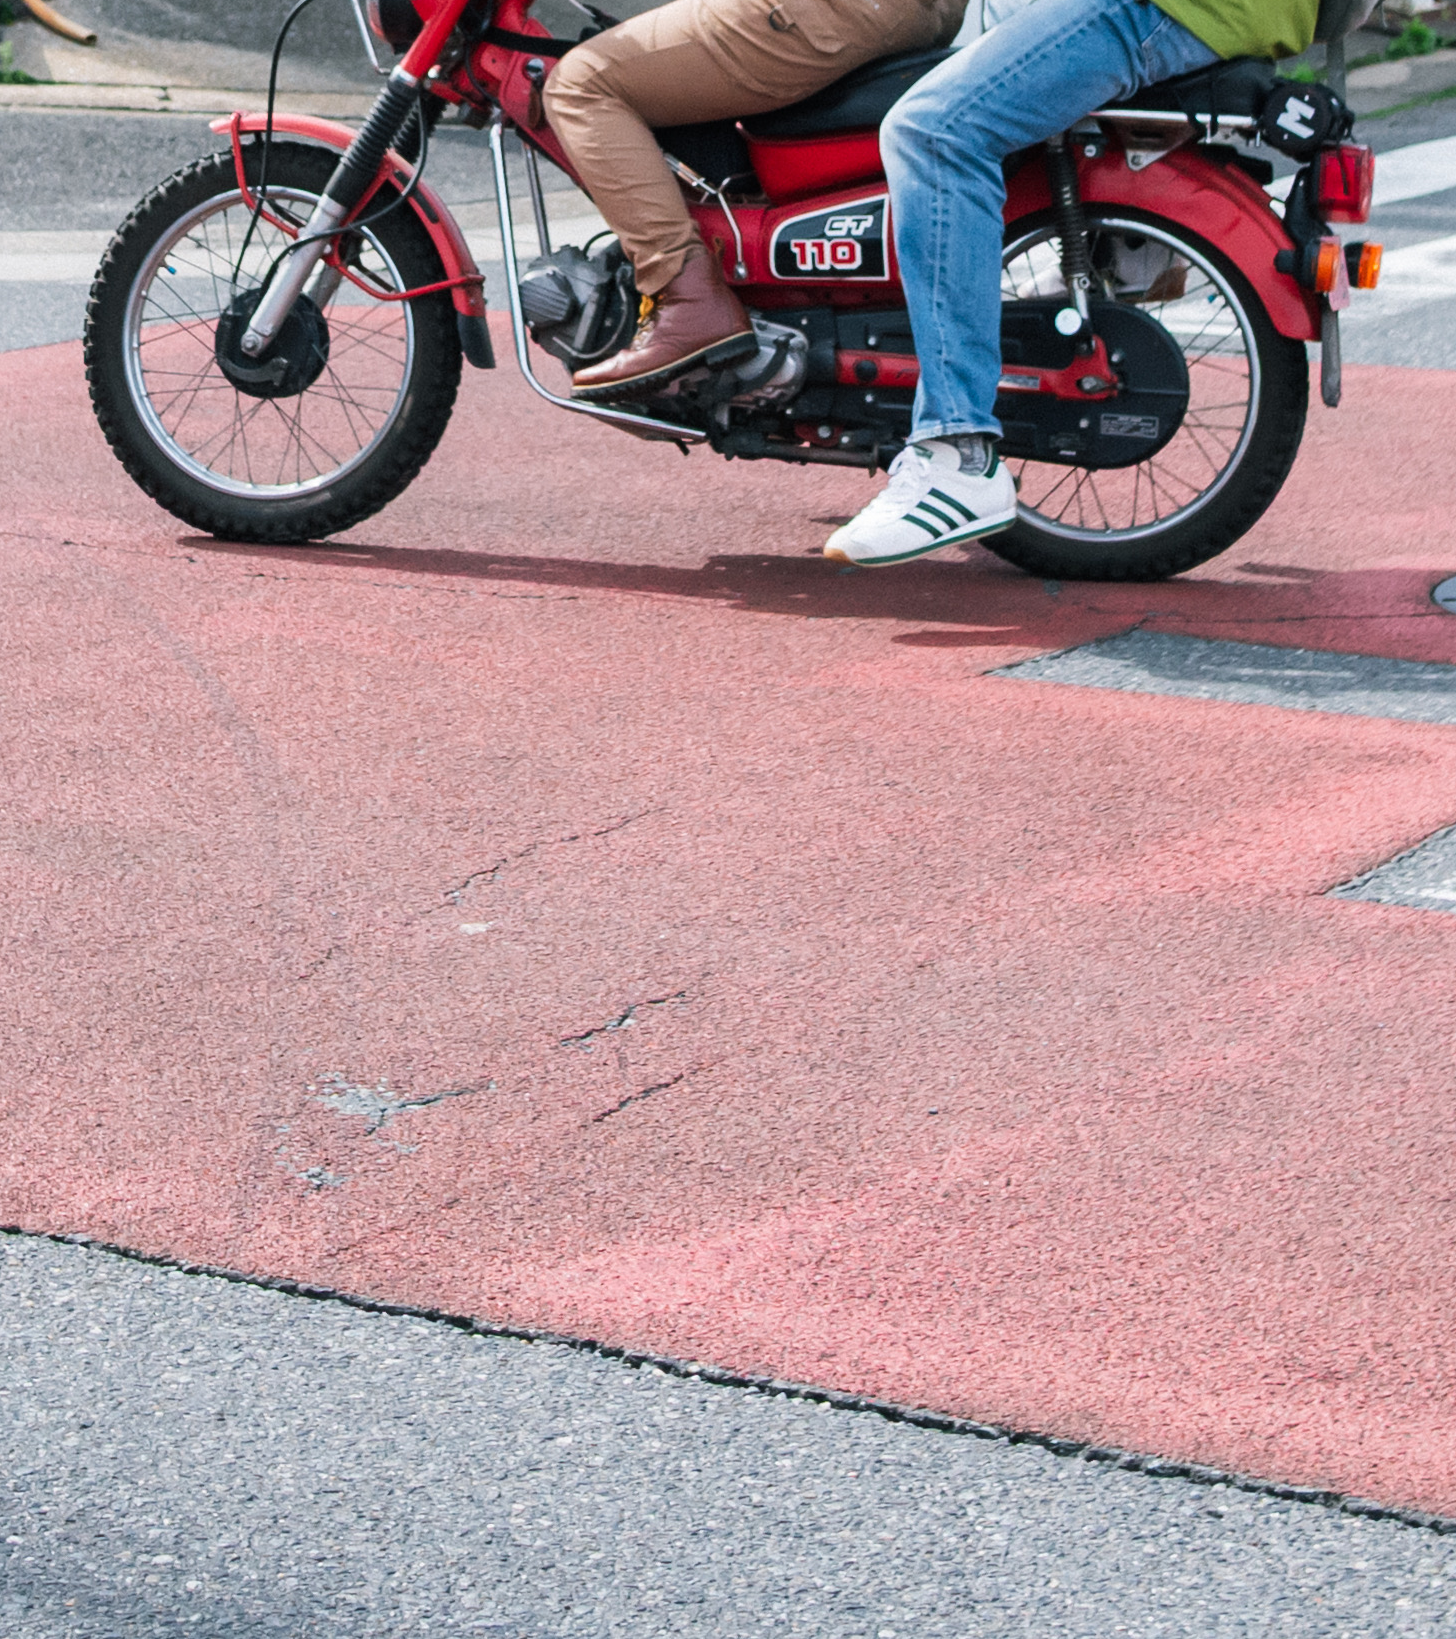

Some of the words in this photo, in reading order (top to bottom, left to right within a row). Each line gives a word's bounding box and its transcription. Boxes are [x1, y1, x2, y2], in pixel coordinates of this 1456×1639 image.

[1277, 97, 1315, 139] M
[825, 215, 874, 236] CT
[791, 239, 861, 269] 110
